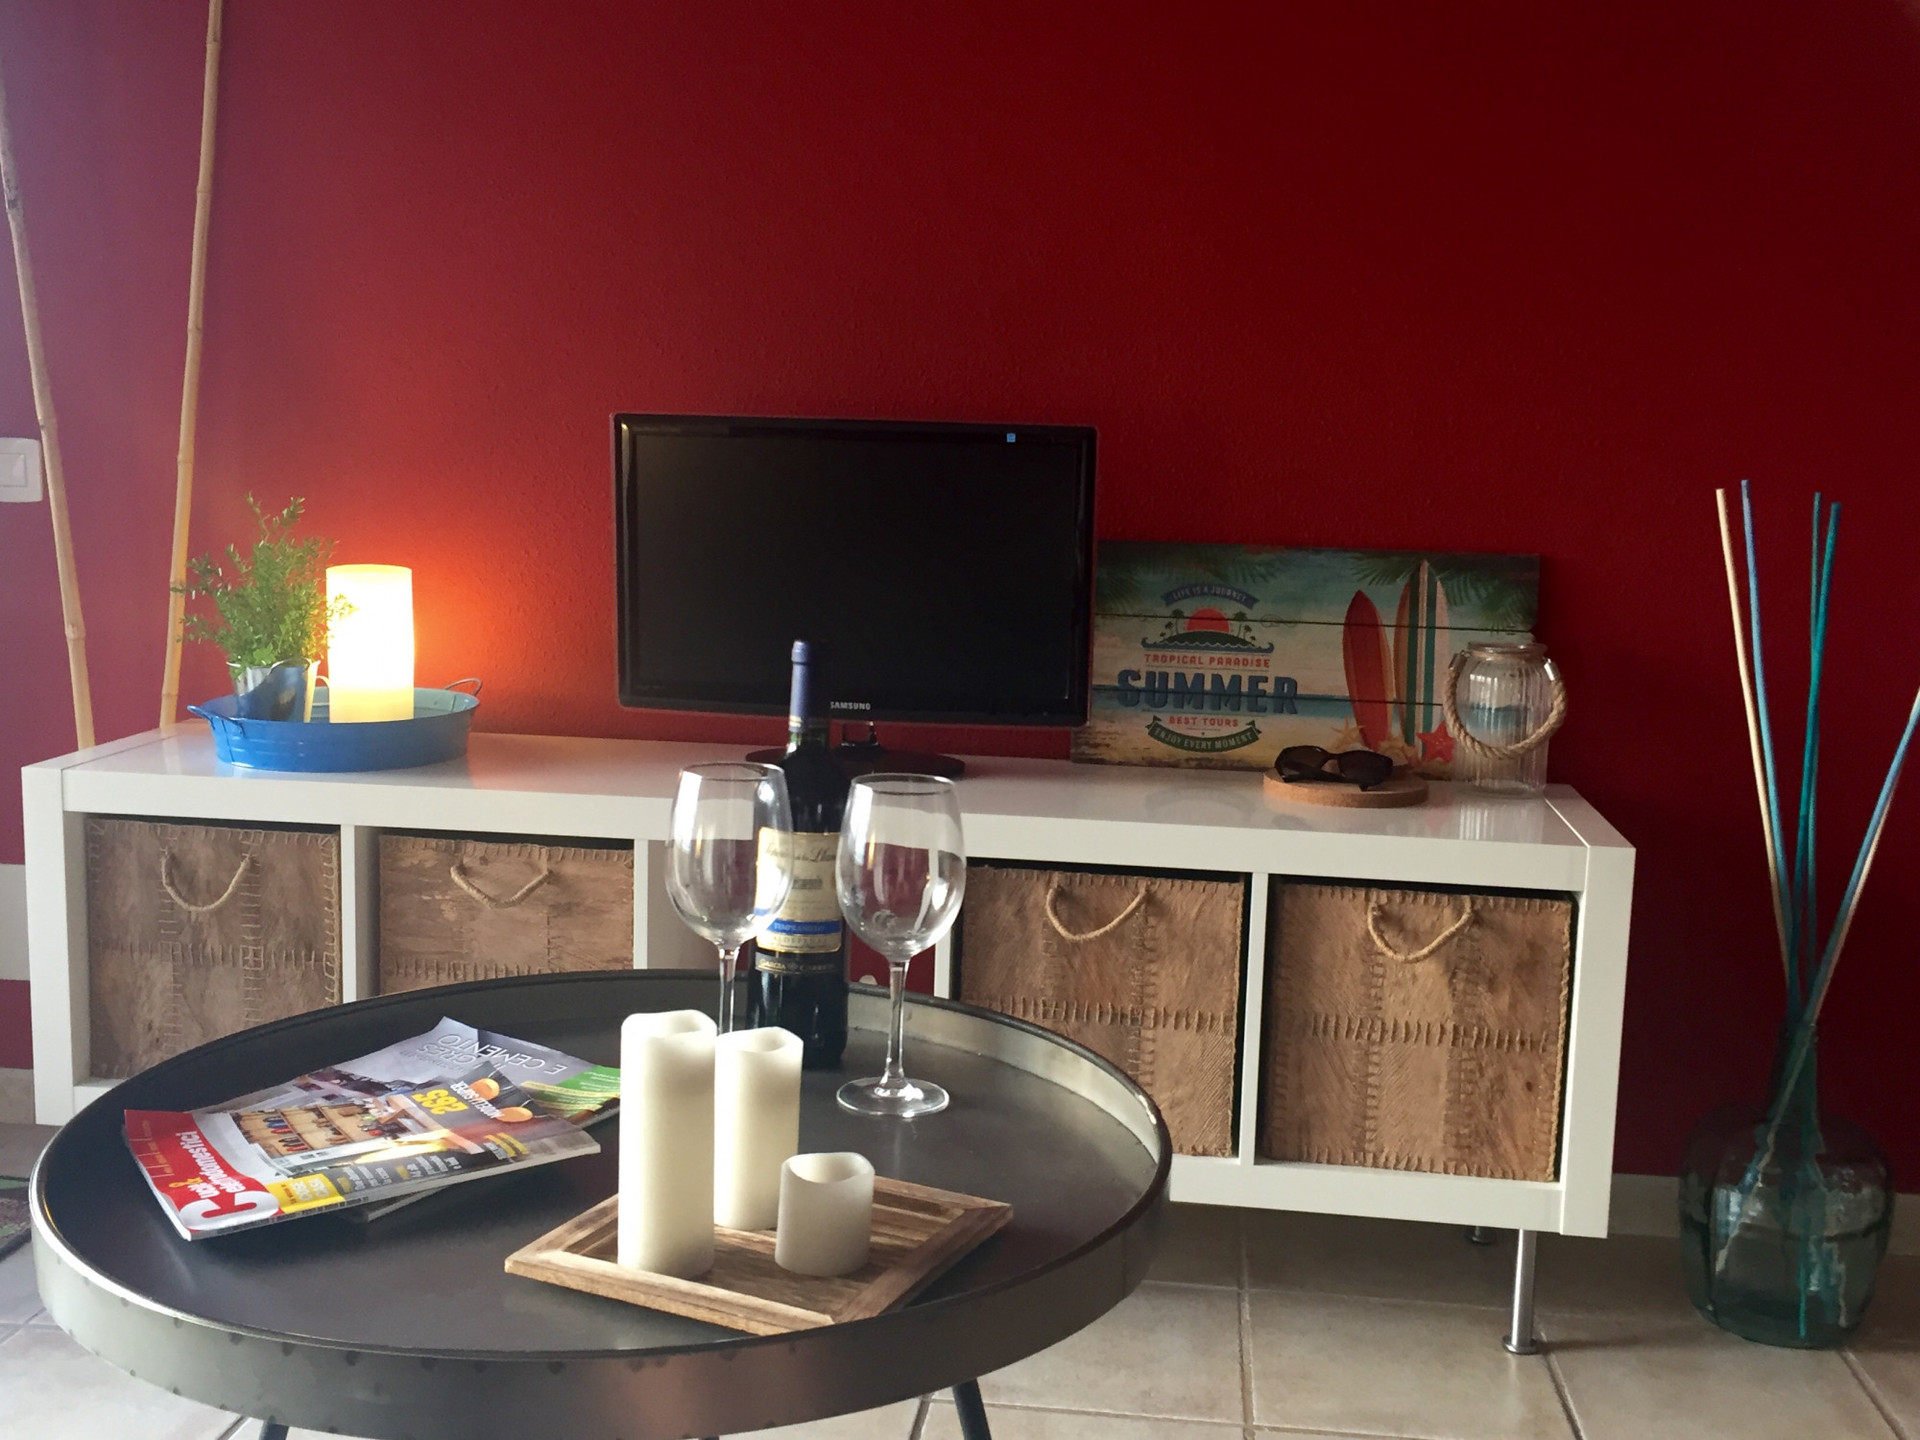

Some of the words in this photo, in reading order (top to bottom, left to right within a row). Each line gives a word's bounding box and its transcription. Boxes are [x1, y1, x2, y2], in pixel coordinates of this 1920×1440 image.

[1172, 588, 1190, 601] LIFE
[1192, 585, 1201, 595] IS
[1202, 585, 1209, 594] A
[1211, 585, 1247, 602] JOURNEY
[1144, 653, 1204, 666] TROPICAL
[1209, 656, 1271, 668] PARADISE
[1117, 669, 1298, 714] SUMMER
[830, 701, 871, 711] SAMSUNG
[1168, 715, 1197, 726] BEST
[1202, 717, 1239, 728] TOURS
[1154, 727, 1182, 745] ENJOY
[1184, 739, 1212, 750] EVERY
[1214, 732, 1254, 749] MOMENT
[416, 1043, 477, 1065] GRES
[438, 1034, 546, 1070] CEMENTO
[543, 1063, 568, 1075] E
[411, 1088, 469, 1115] 265
